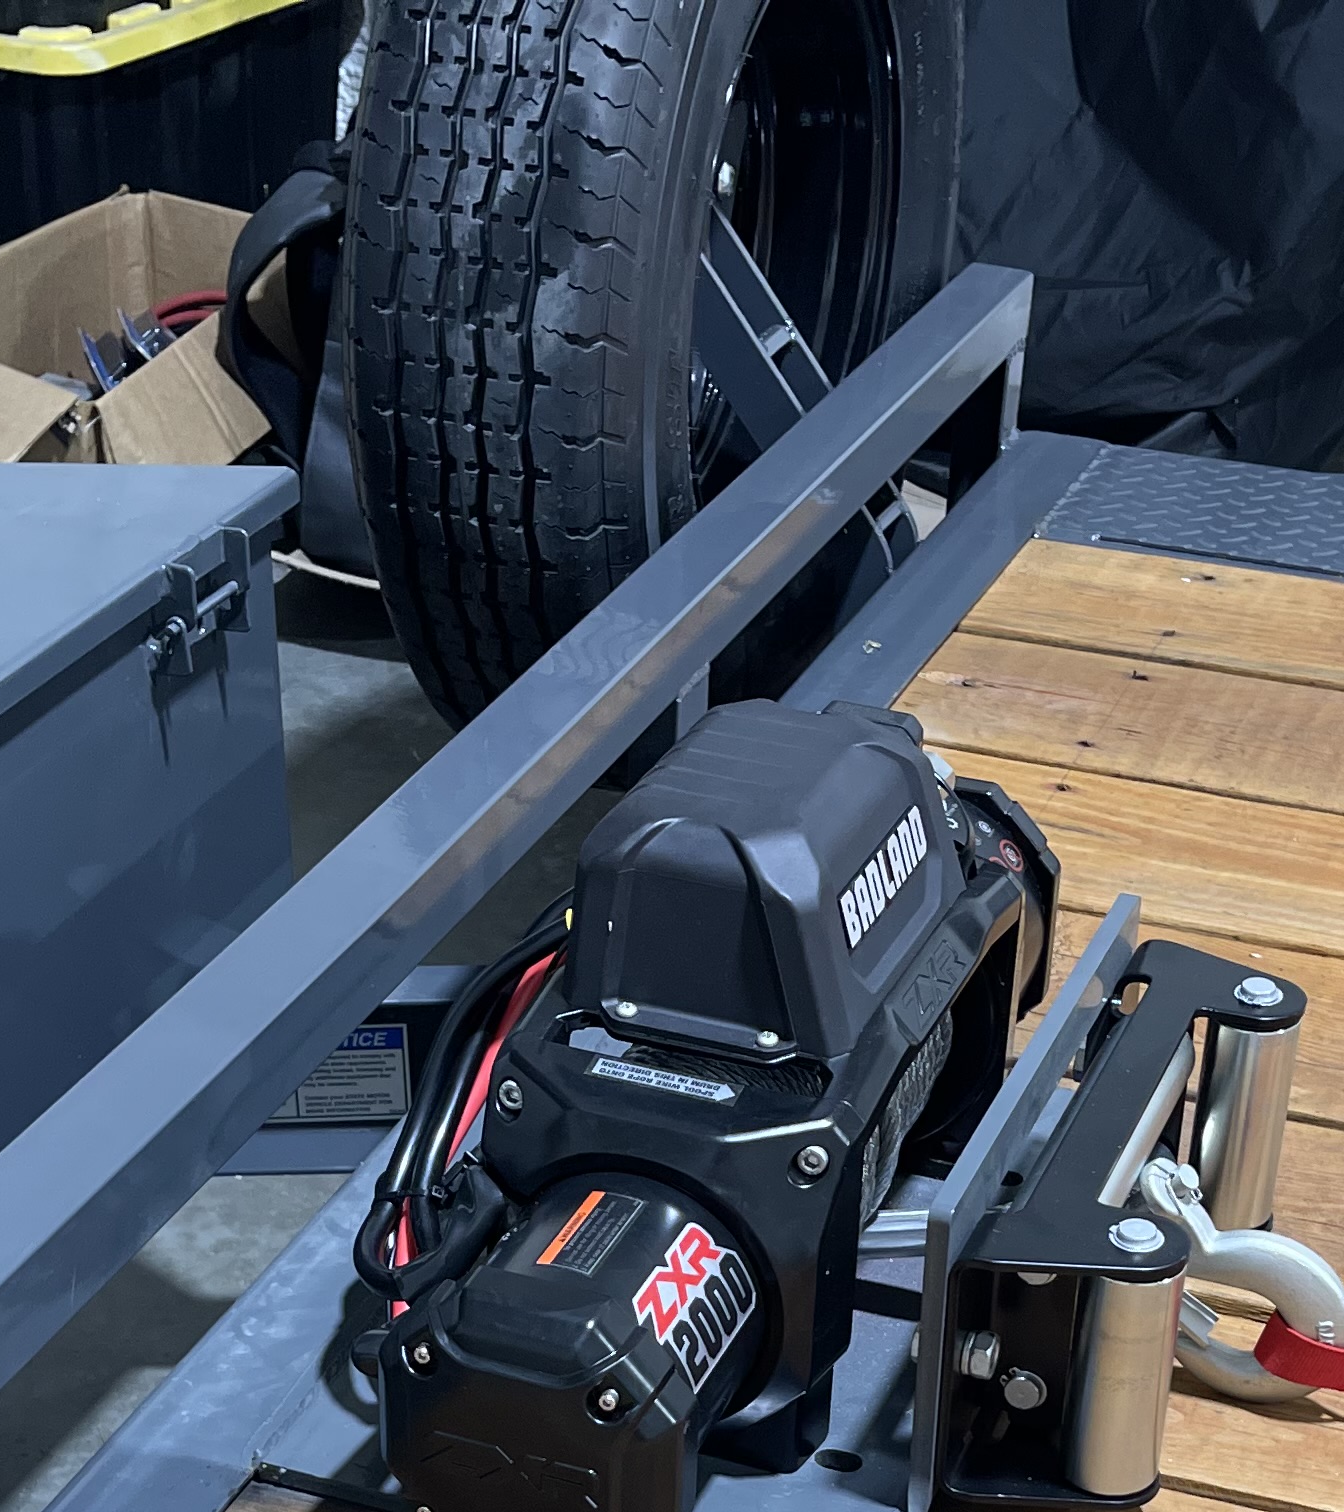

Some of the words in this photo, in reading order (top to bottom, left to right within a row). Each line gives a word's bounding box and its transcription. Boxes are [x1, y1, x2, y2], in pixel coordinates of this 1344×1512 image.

[840, 805, 927, 949] BADLAND
[902, 939, 967, 1030] ZXR
[598, 1067, 625, 1078] ONTO
[600, 1060, 653, 1077] DIRECTION
[627, 1073, 654, 1084] ROPE
[654, 1072, 676, 1082] THIS
[678, 1076, 690, 1085] IN
[654, 1079, 681, 1090] WIRE
[690, 1079, 721, 1091] DRUM
[685, 1086, 716, 1097] SPOOL
[636, 1227, 721, 1339] ZXR
[672, 1252, 753, 1387] 2000
